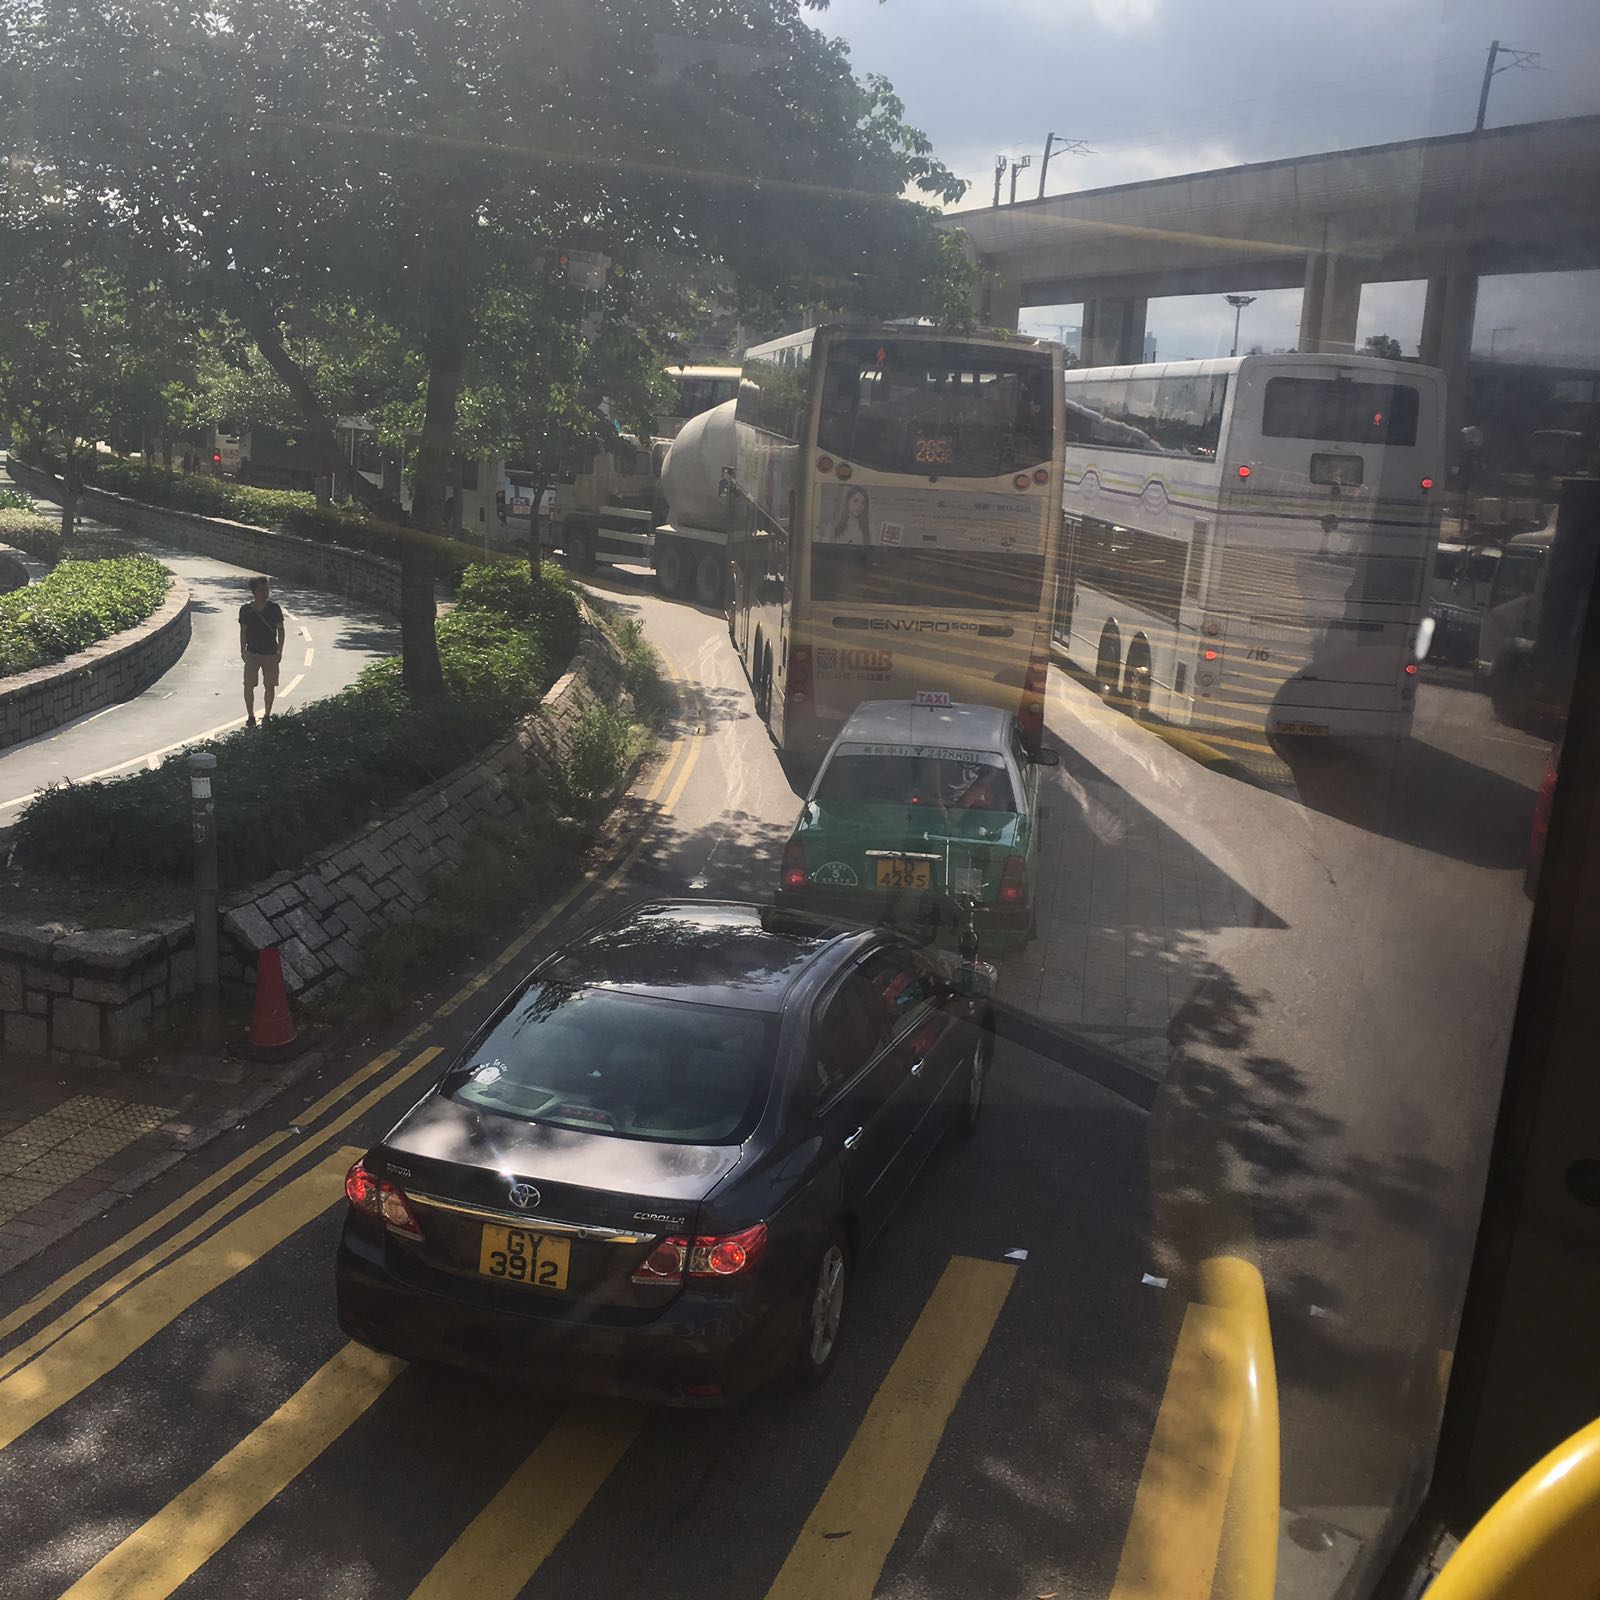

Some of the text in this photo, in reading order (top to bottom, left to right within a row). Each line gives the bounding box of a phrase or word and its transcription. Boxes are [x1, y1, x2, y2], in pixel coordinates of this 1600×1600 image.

[918, 693, 947, 704] TAXI
[832, 869, 840, 878] 5
[880, 872, 927, 888] 4295
[386, 1163, 412, 1177] TOYOTA
[633, 1212, 686, 1225] COROLLA
[507, 1230, 546, 1258] GY
[489, 1251, 559, 1286] 3912
